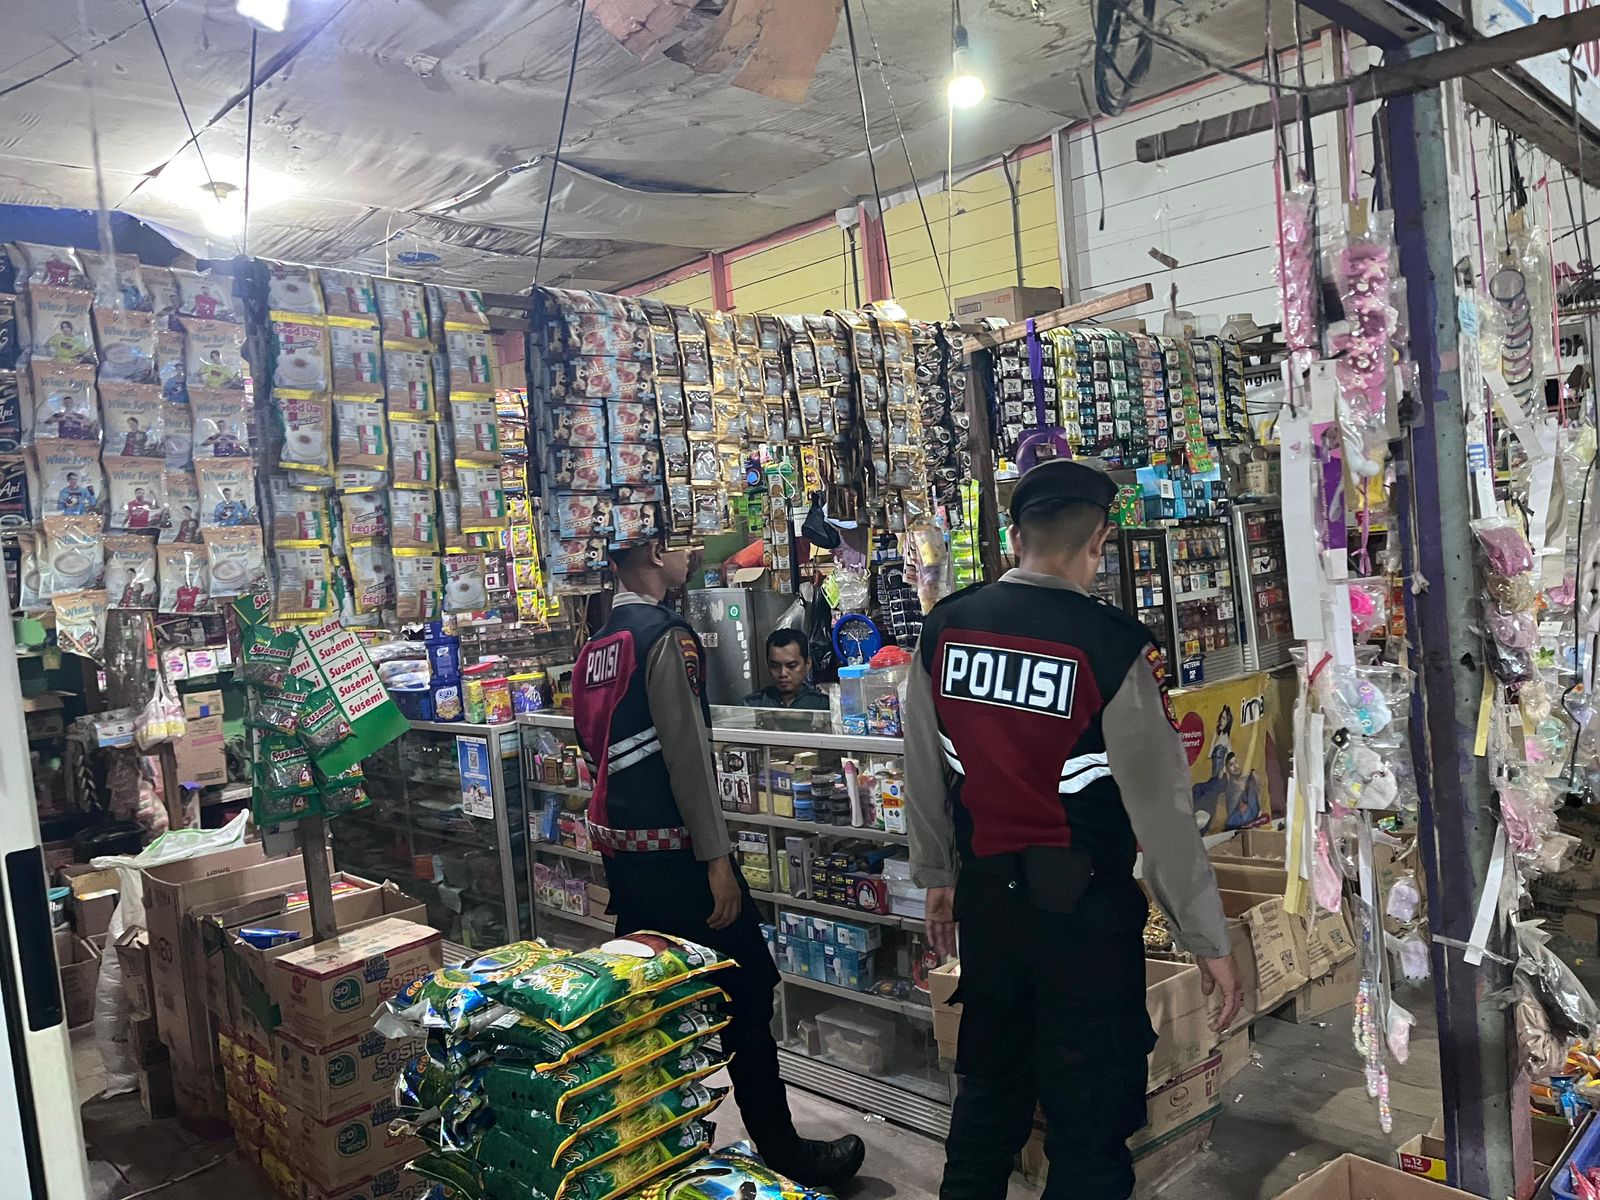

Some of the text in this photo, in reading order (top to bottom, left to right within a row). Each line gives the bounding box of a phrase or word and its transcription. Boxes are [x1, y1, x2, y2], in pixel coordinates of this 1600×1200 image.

[273, 323, 321, 340] Good Day
[279, 399, 304, 412] Good
[309, 620, 341, 641] Susem
[250, 644, 293, 658] Susemi
[319, 633, 354, 660] Susemi
[290, 656, 311, 676] emi
[329, 652, 364, 679] Susemi
[586, 642, 620, 685] POLISI
[339, 670, 374, 697] Susemi
[945, 648, 1072, 712] POLISI
[303, 699, 335, 728] Susemi
[349, 688, 383, 716] Susemi
[271, 748, 306, 762] Susem
[334, 984, 349, 997] SO
[379, 964, 431, 994] SOSIS
[1411, 1157, 1423, 1167] 12
